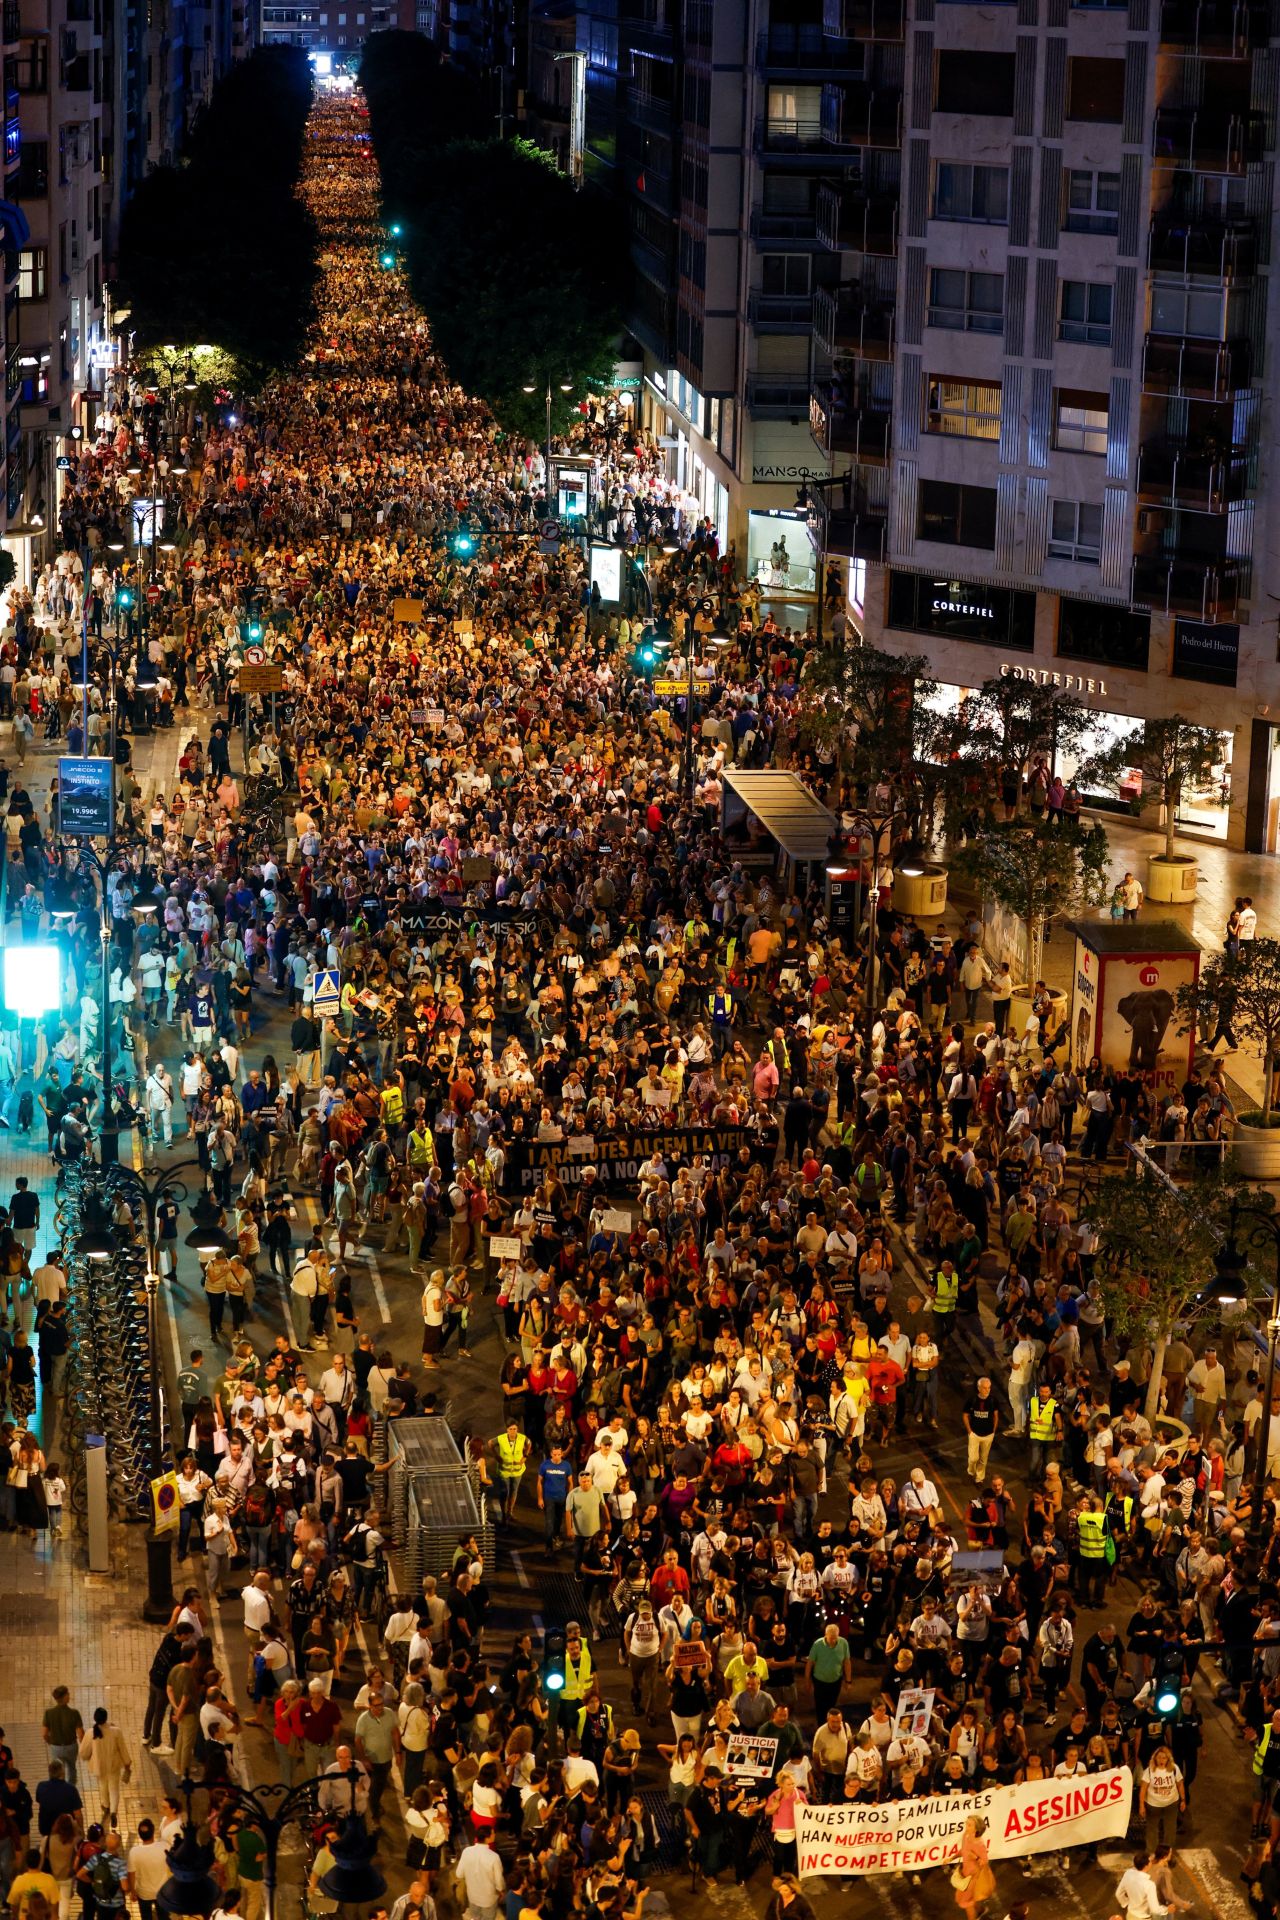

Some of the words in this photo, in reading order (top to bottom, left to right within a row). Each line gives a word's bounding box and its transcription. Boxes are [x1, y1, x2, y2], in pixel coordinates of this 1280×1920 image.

[753, 466, 809, 477] MANGO
[932, 600, 994, 618] CORTEFIEL
[1181, 634, 1201, 646] Pedro
[1201, 638, 1213, 649] del
[1214, 640, 1237, 653] Hierro
[1000, 664, 1107, 695] CORTEFIEL
[400, 911, 462, 930] MAZÓN
[692, 1133, 714, 1153] LA
[615, 1159, 638, 1179] NO
[730, 1736, 776, 1748] JUSTICIA
[1153, 1775, 1173, 1786] 20:11
[802, 1808, 889, 1825] NUESTROS
[898, 1794, 992, 1822] FAMILIARES
[1004, 1775, 1124, 1838] ASESINOS
[801, 1829, 832, 1844] HAN
[834, 1831, 893, 1846] MUERTO
[896, 1826, 924, 1843] POR
[928, 1816, 991, 1837] VUESA
